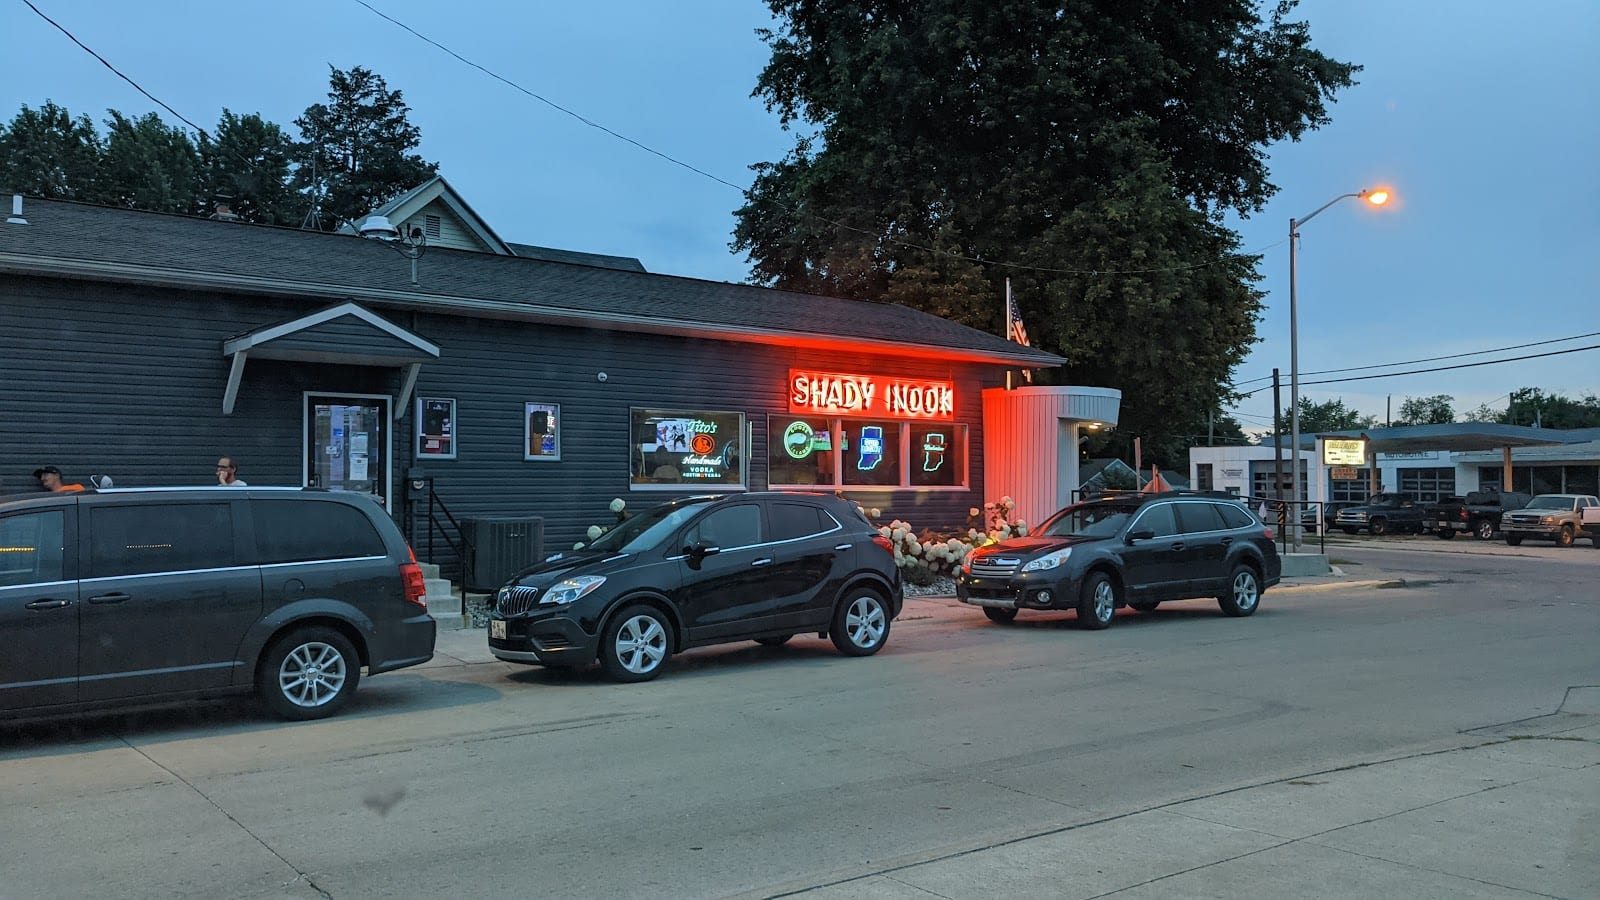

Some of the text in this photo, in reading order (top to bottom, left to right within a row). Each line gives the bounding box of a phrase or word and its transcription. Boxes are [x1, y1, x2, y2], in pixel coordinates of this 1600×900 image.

[791, 375, 953, 413] SHADY NOOK
[687, 420, 718, 434] Tito's
[681, 454, 722, 466] Handmade
